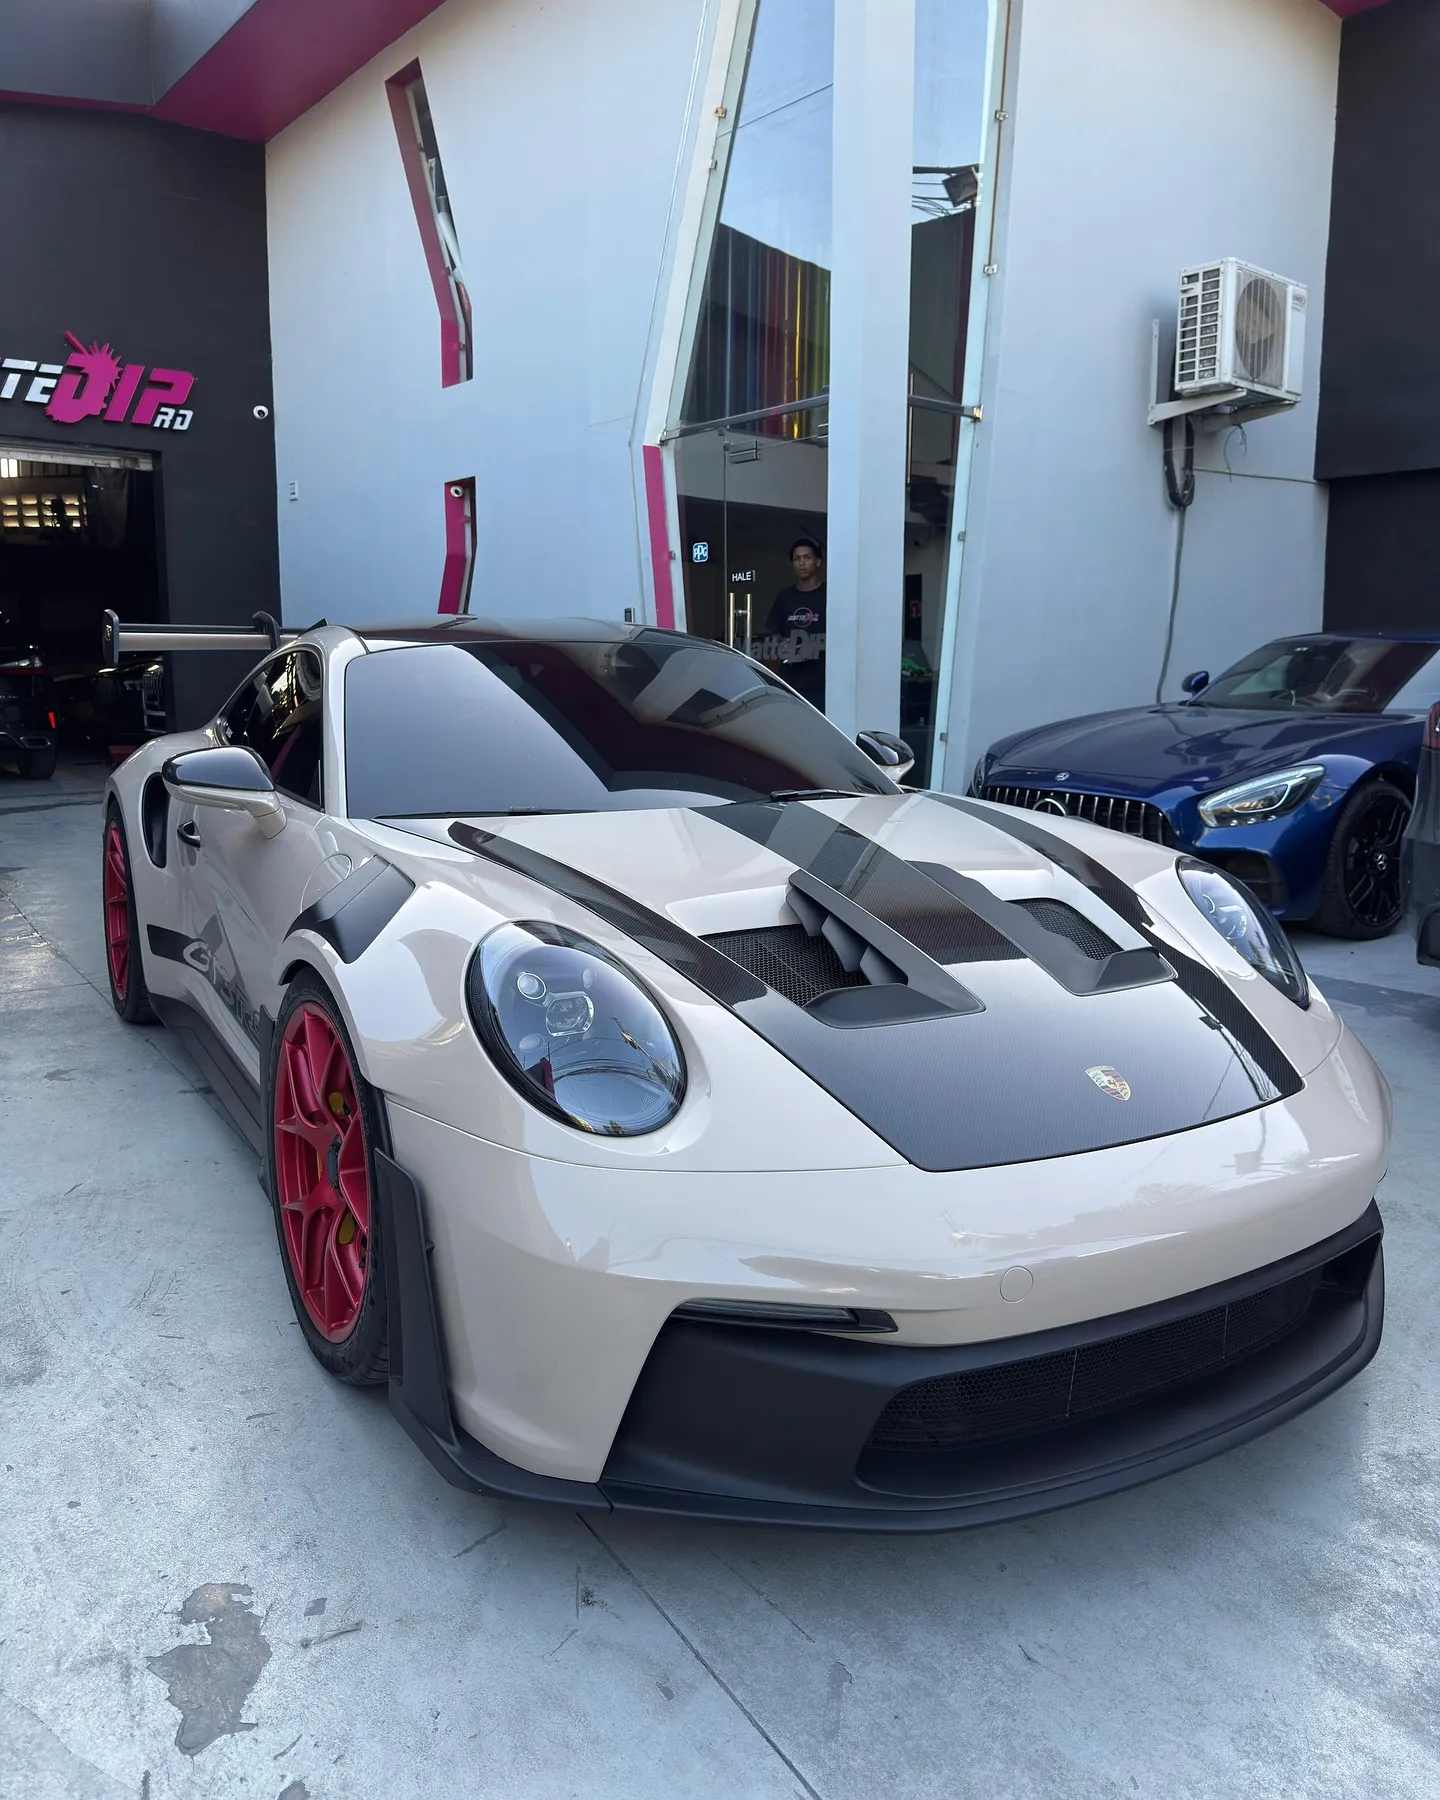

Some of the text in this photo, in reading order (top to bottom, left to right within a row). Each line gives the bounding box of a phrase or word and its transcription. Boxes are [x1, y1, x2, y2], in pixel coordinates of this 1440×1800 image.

[153, 407, 194, 431] RD
[694, 545, 708, 560] PPG
[731, 571, 752, 582] HALE
